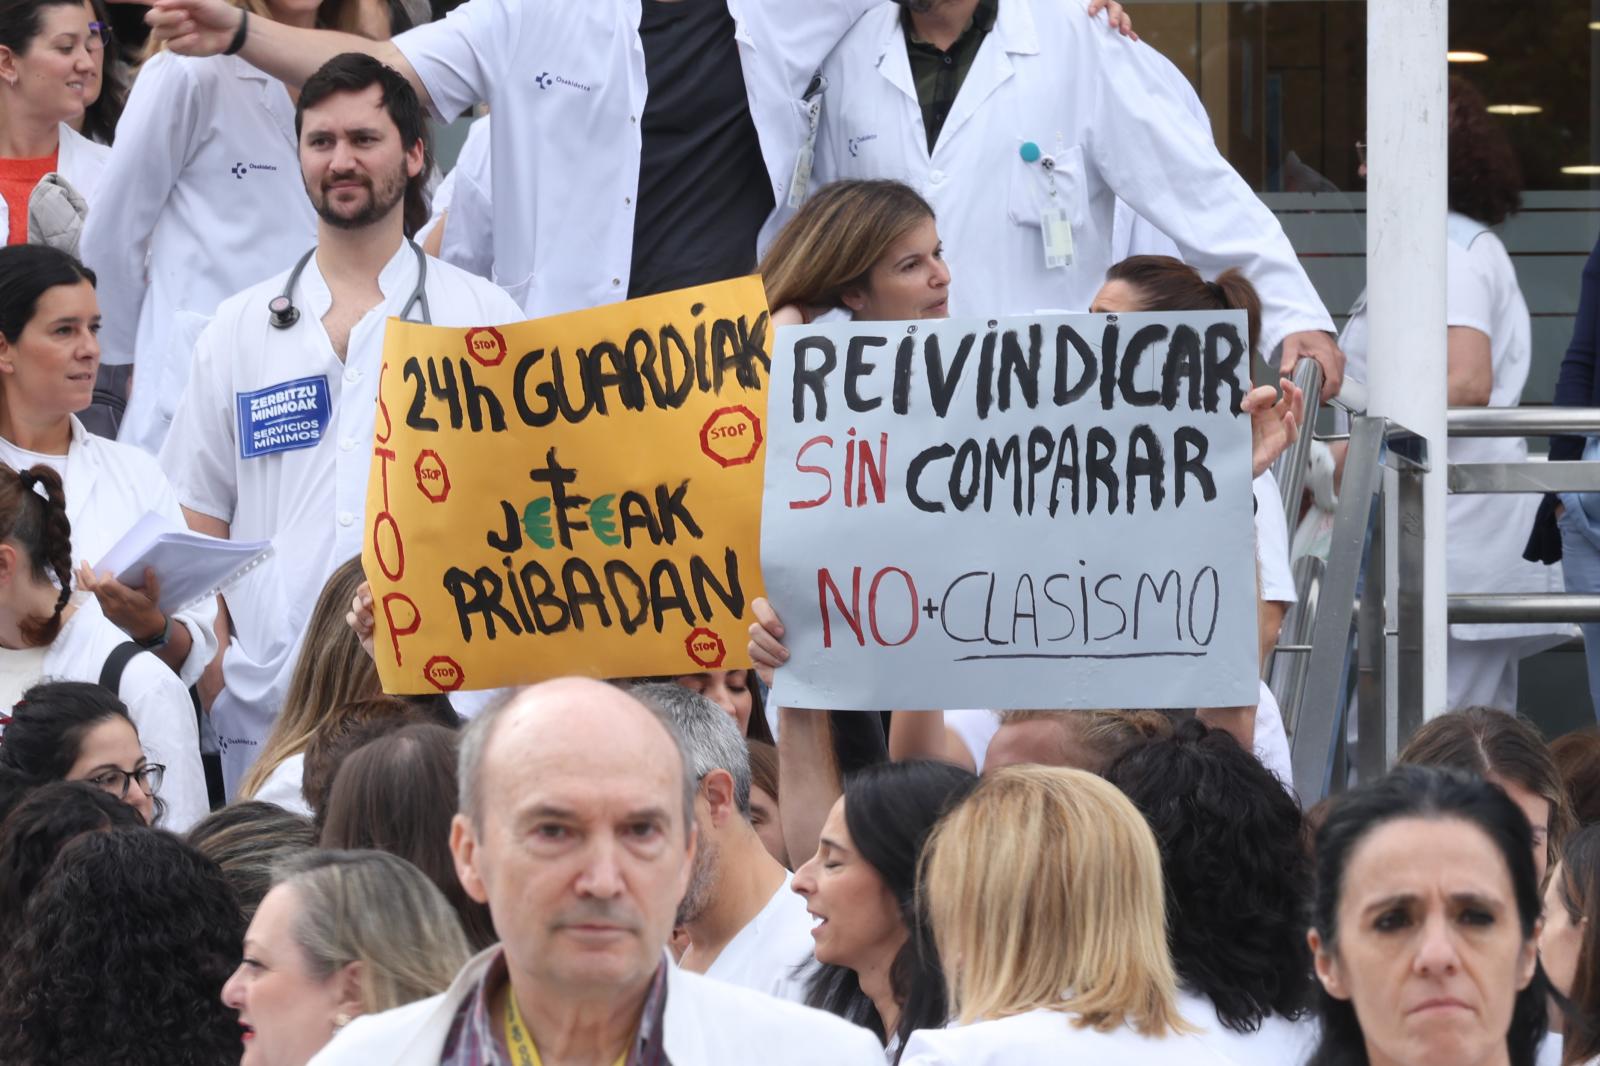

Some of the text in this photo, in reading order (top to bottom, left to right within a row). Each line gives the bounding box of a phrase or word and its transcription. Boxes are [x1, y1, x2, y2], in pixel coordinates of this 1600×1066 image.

[474, 339, 496, 350] STOP
[792, 314, 1246, 422] REIVINDICAR
[251, 385, 318, 411] ZERBITZU
[403, 356, 508, 433] 24h
[251, 397, 318, 422] MINIMOAK
[253, 419, 320, 440] SERVICIOS
[254, 429, 320, 449] MÍNIMOS
[710, 423, 747, 440] STOP
[421, 468, 441, 480] STOP
[790, 424, 1216, 518] SIN COMPARAR
[693, 642, 716, 651] STOP
[431, 667, 455, 678] STOP
